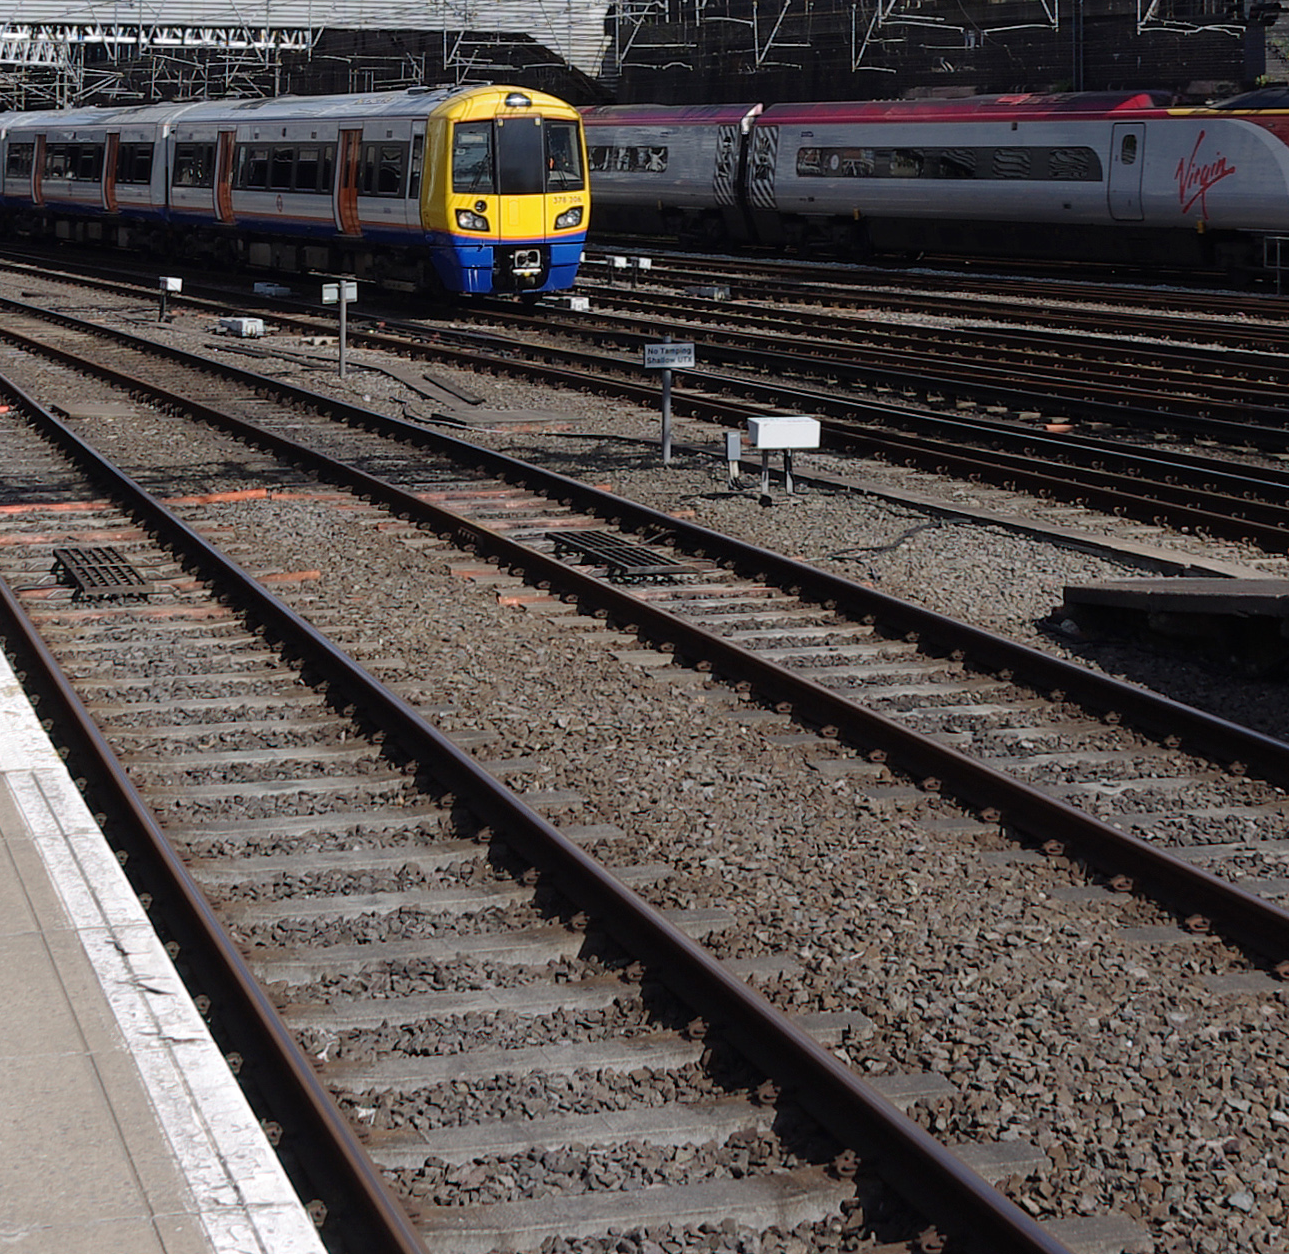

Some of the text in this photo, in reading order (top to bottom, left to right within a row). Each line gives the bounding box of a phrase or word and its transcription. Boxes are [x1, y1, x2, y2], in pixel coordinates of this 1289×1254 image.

[1174, 130, 1236, 220] Virgin
[647, 347, 692, 355] No Tamping
[647, 356, 676, 364] Shallow
